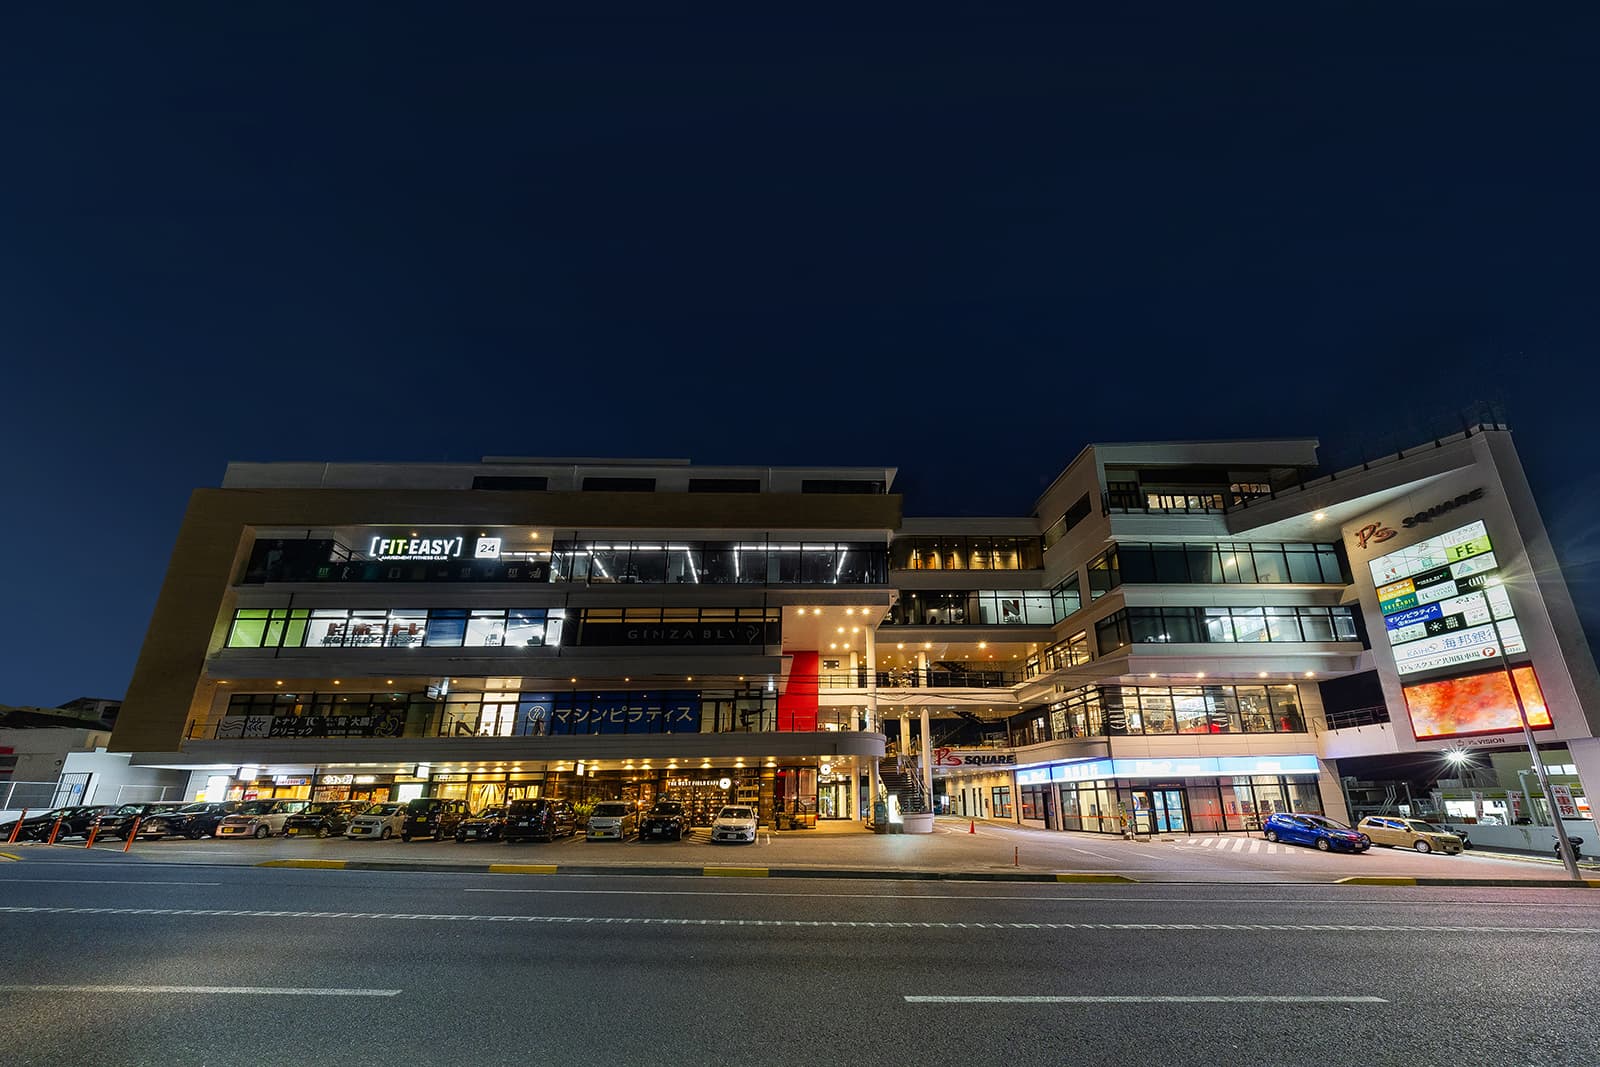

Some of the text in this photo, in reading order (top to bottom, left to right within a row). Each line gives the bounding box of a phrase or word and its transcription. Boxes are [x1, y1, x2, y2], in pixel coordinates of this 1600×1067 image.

[480, 544, 496, 553] 24
[627, 629, 694, 639] GINZA
[553, 705, 693, 723] マシンピラティス
[273, 717, 298, 725] トナリ
[271, 727, 313, 735] クリニック
[1479, 737, 1505, 745] VISION
[933, 747, 1014, 766] P's SQUARE
